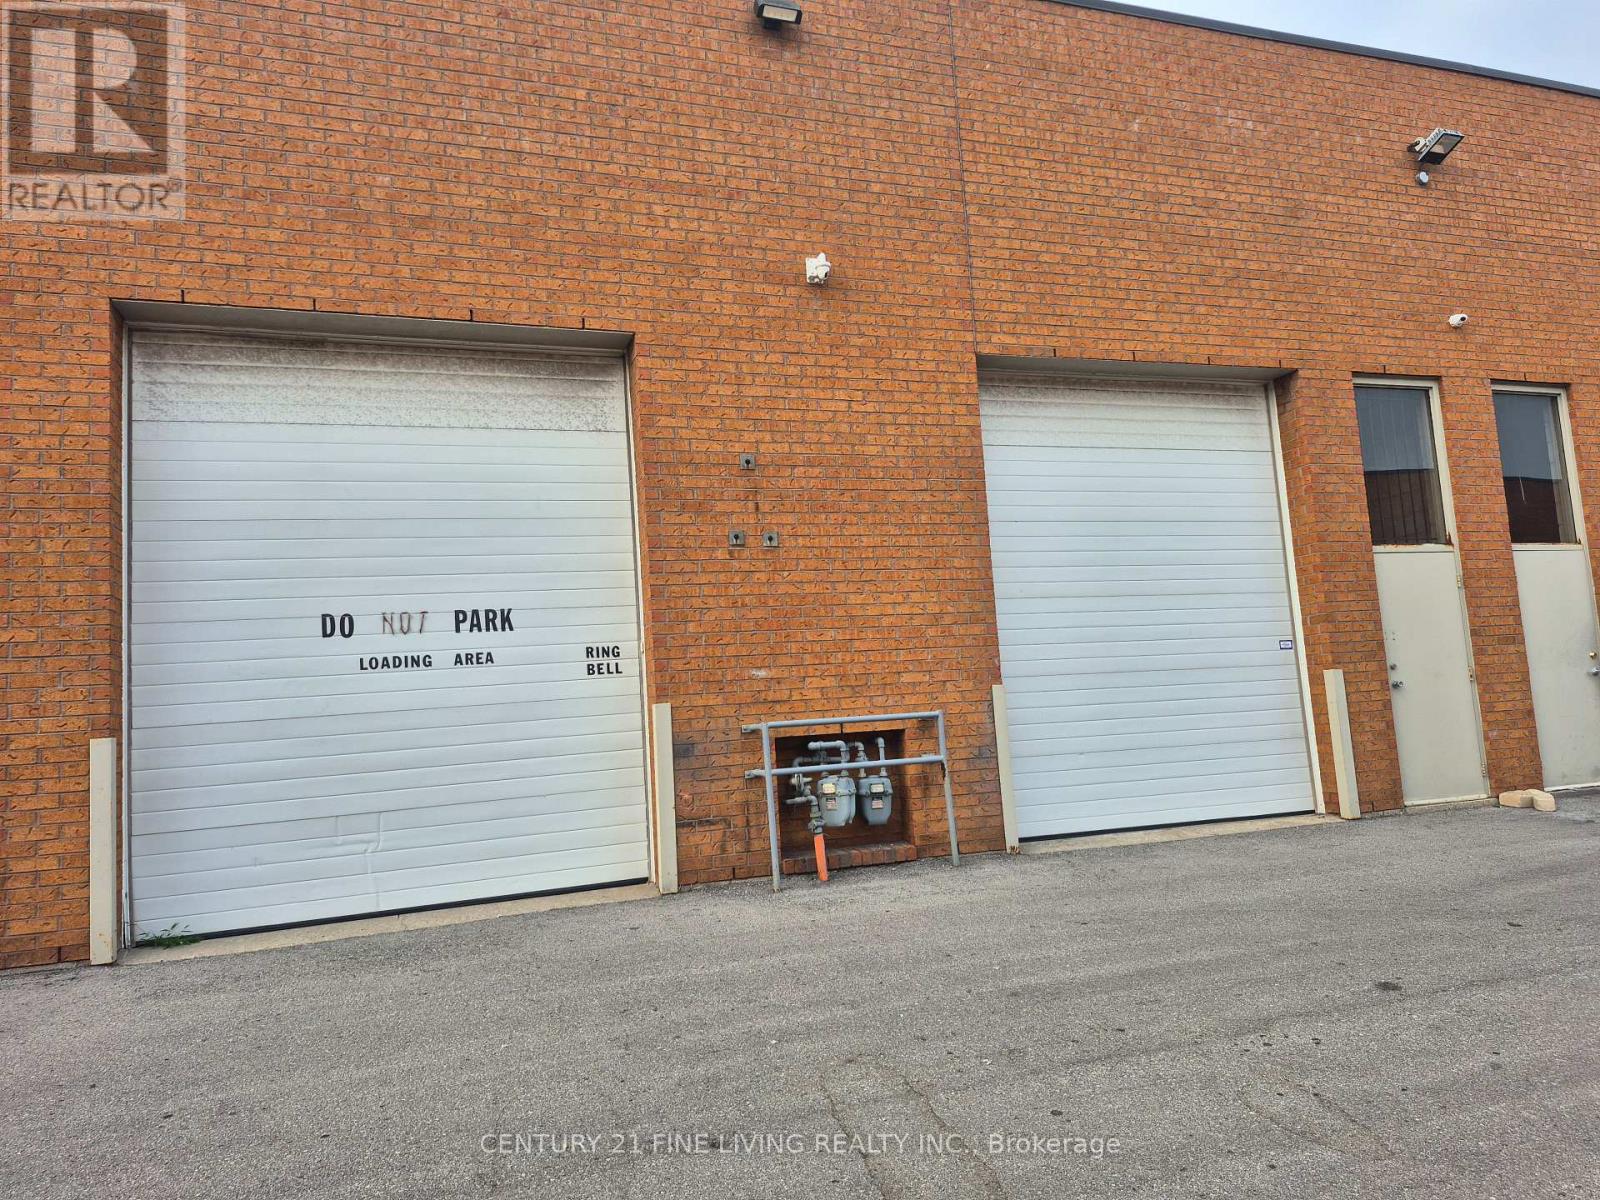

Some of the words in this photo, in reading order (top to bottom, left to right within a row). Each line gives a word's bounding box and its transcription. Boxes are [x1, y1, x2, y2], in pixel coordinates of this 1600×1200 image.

[321, 613, 355, 638] DO
[381, 611, 429, 635] NOT
[454, 608, 514, 633] PARK
[585, 645, 621, 659] RING
[359, 654, 433, 671] LOADING
[454, 652, 495, 666] AREA
[586, 662, 623, 676] BELL
